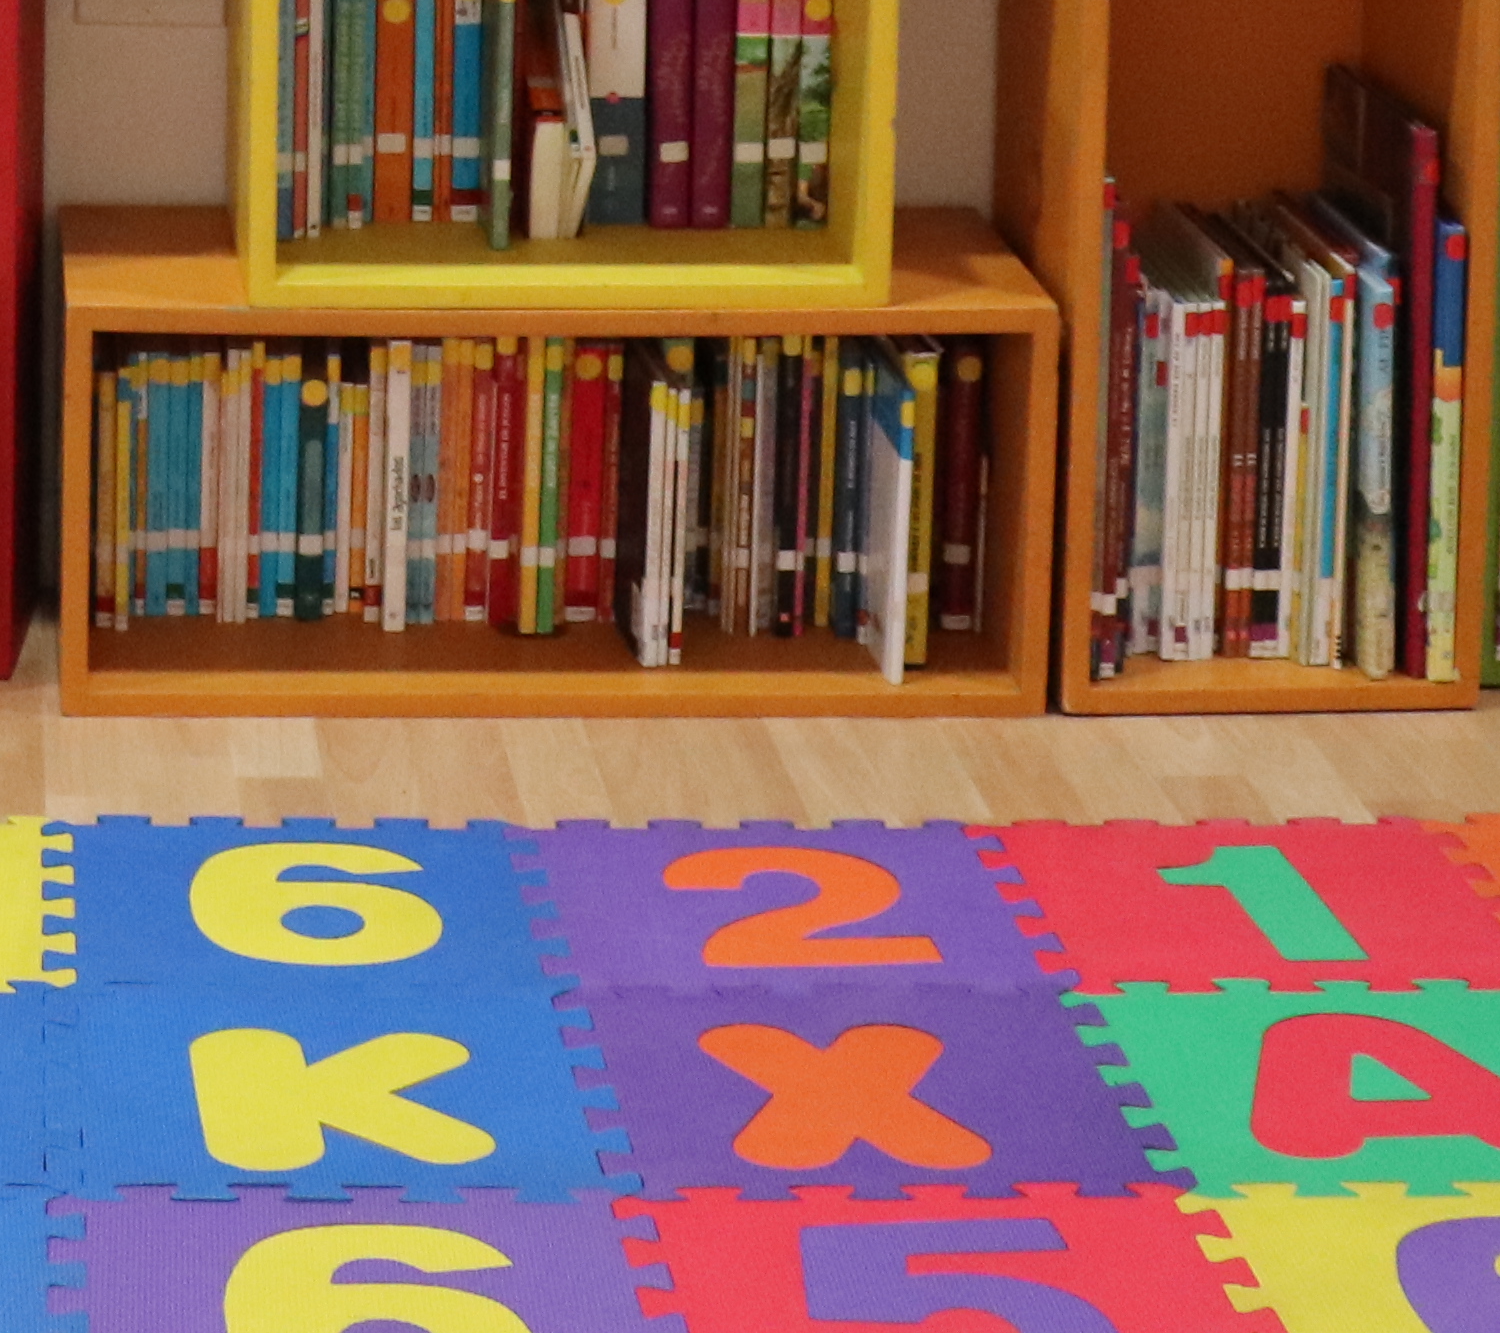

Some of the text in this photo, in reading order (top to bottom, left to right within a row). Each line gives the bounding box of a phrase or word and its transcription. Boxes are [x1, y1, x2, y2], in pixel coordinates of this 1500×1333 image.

[188, 841, 444, 968] 6
[661, 846, 944, 968] 2
[1155, 843, 1370, 963] 1
[188, 1028, 497, 1172] K
[697, 1022, 993, 1171] X
